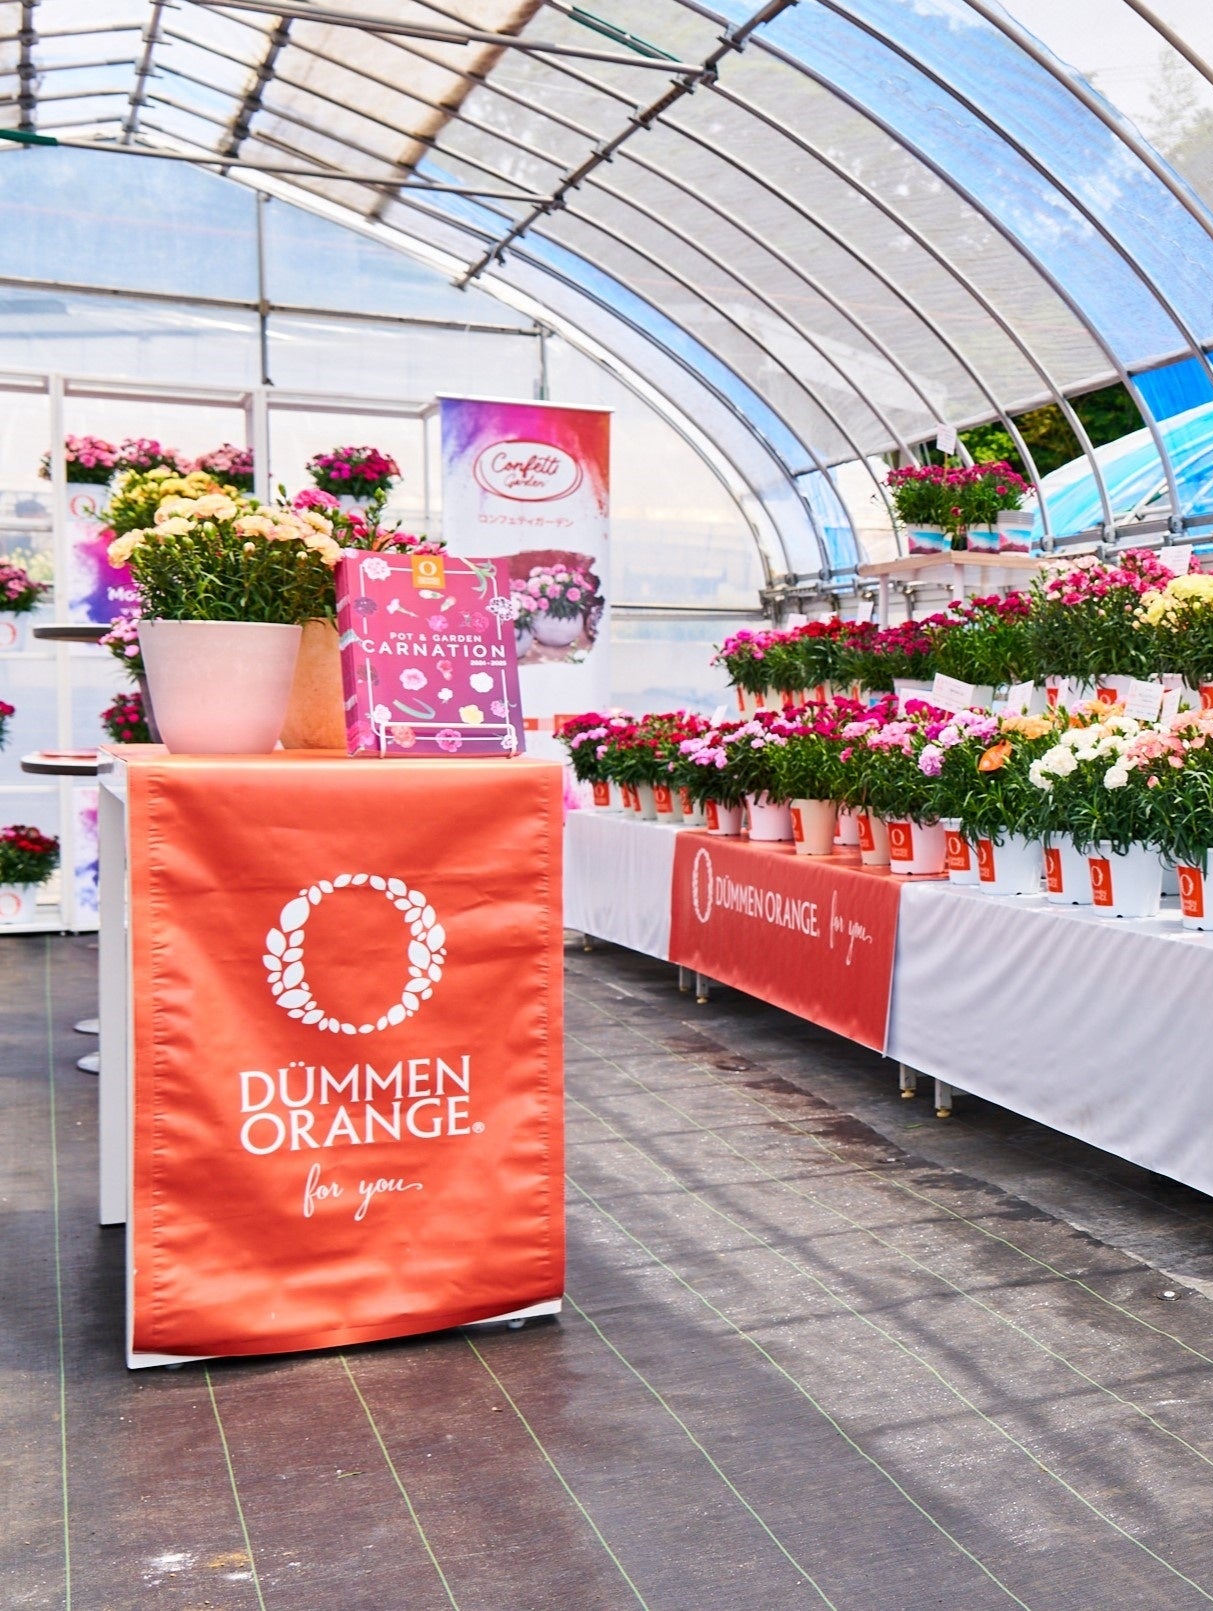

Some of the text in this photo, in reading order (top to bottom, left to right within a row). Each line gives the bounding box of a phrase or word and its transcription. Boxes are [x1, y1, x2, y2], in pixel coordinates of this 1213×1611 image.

[491, 452, 561, 478] Confetti
[361, 639, 506, 658] CARNATION
[389, 631, 482, 643] POT & GARDEN
[715, 875, 764, 919] DÜMMEN
[239, 1055, 471, 1113] DÜMMEN
[303, 1162, 424, 1221] for you
